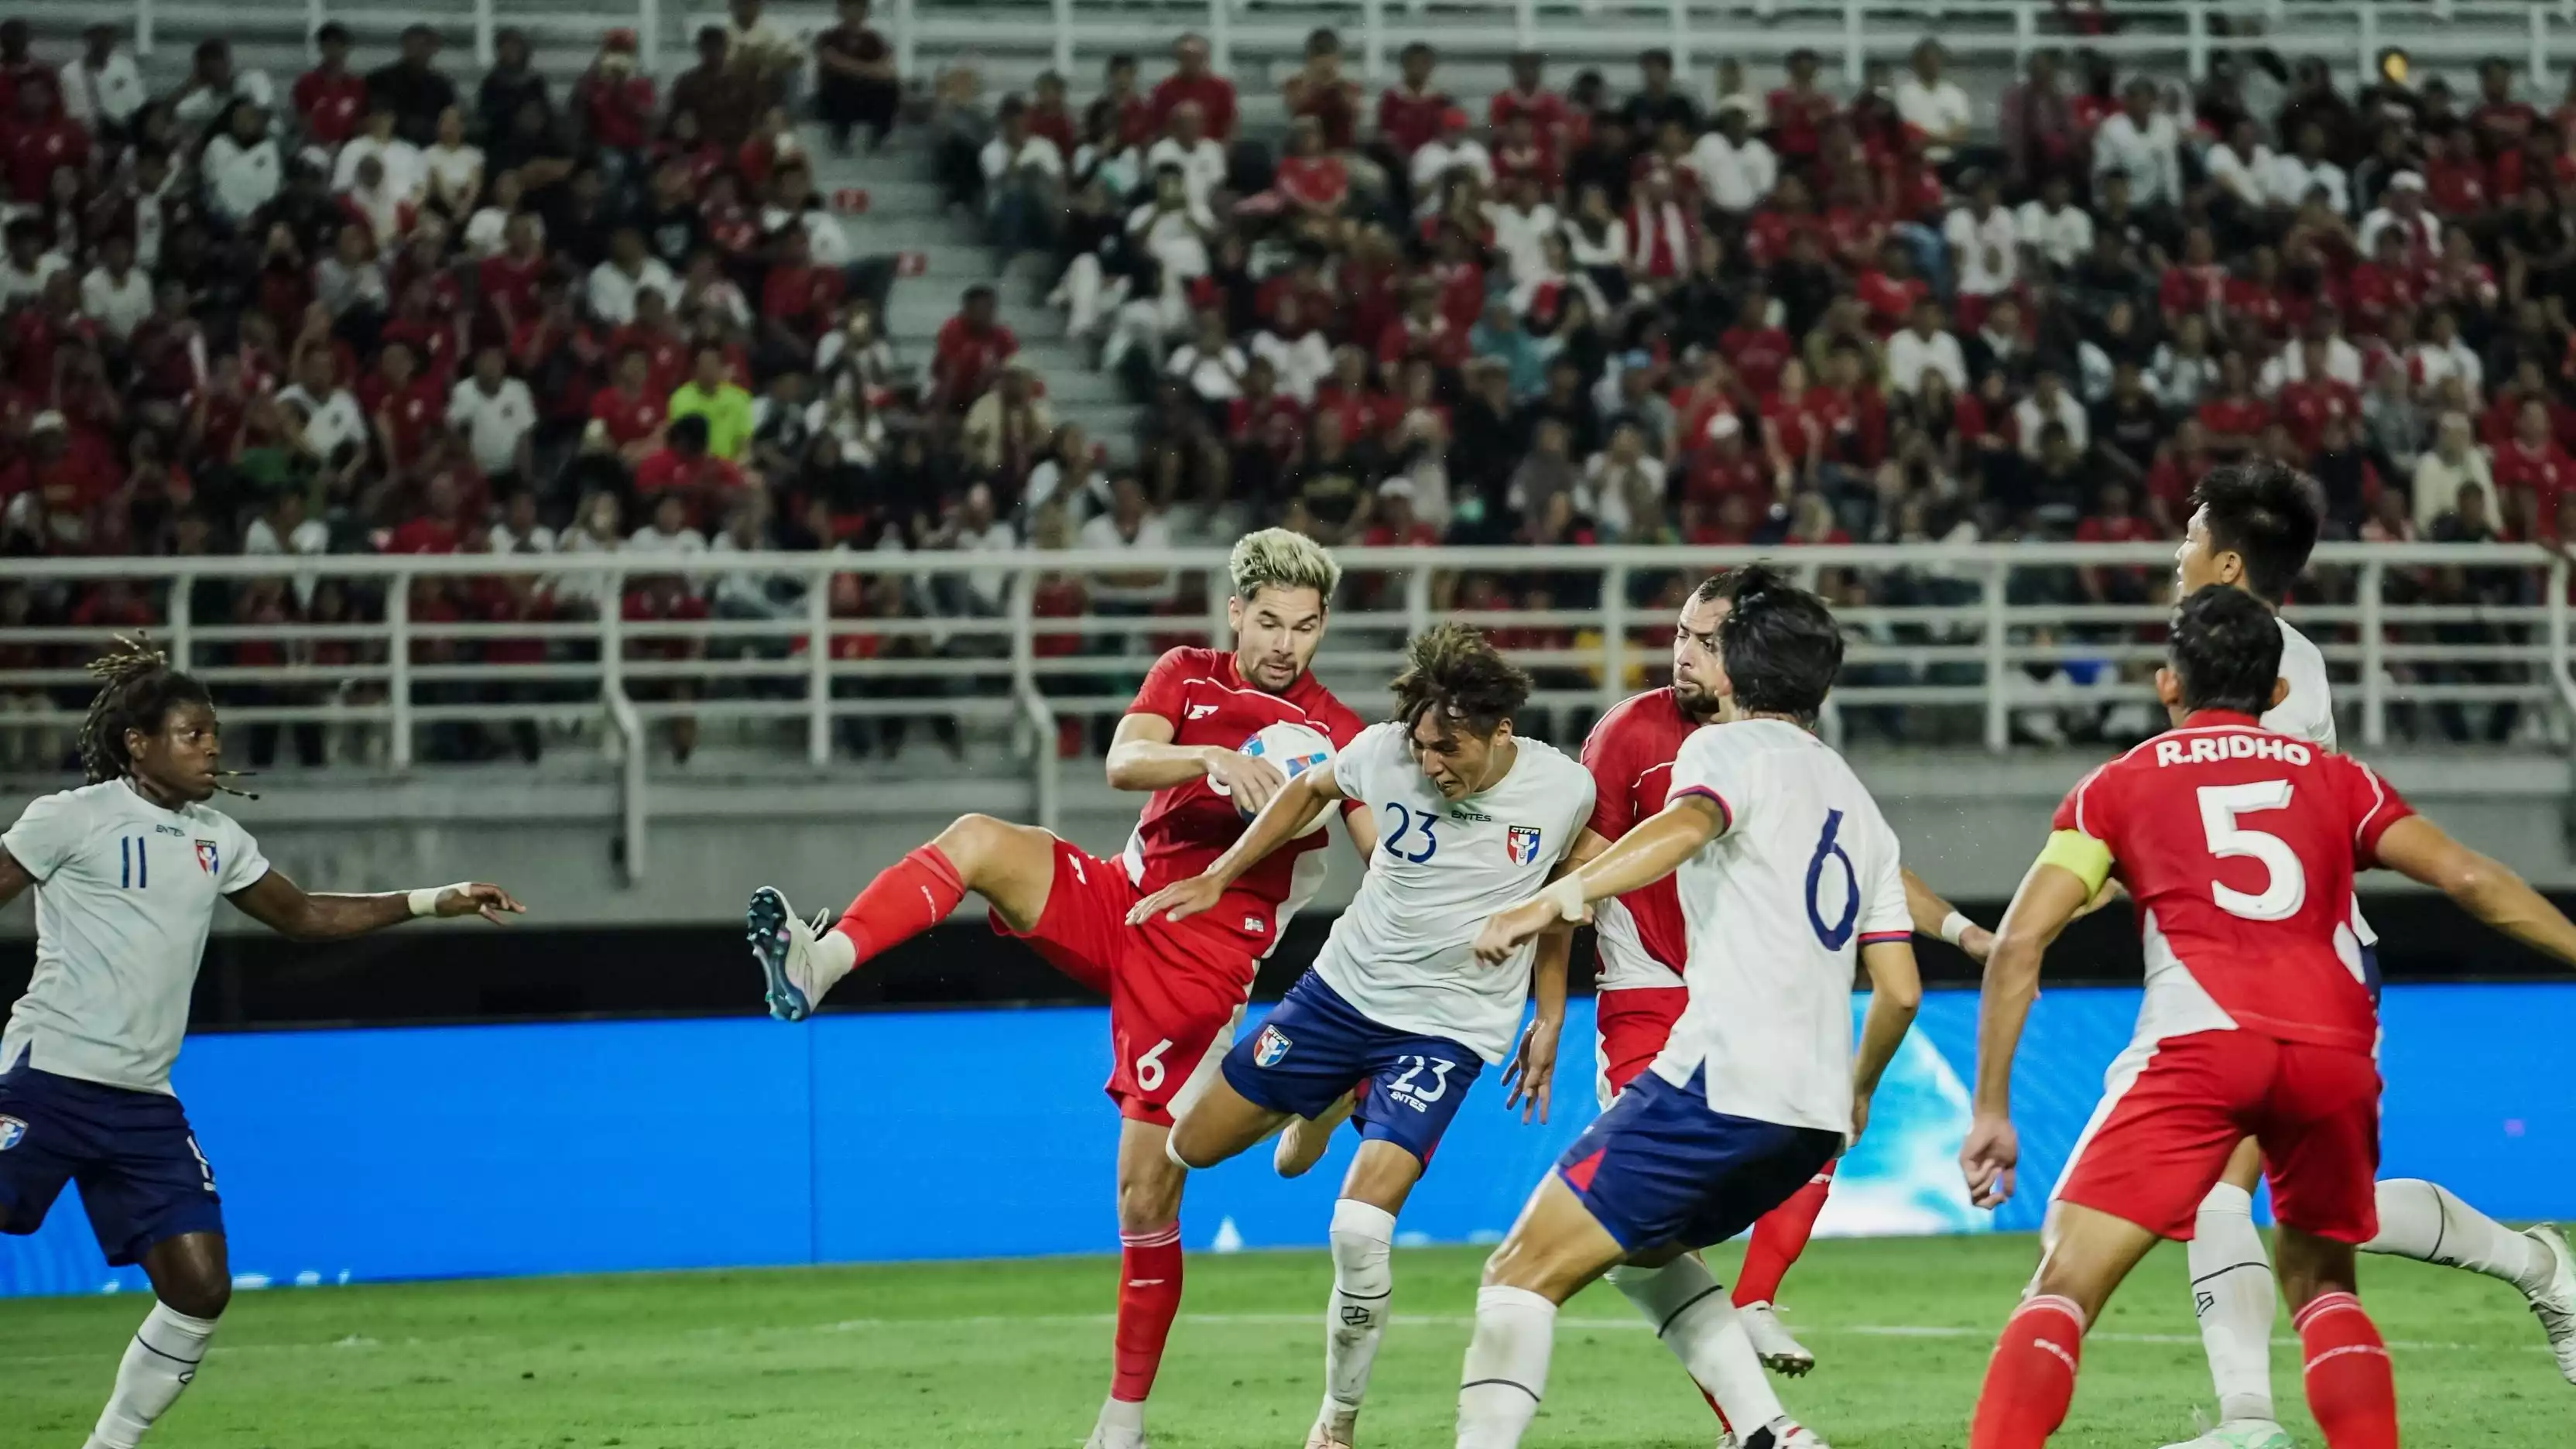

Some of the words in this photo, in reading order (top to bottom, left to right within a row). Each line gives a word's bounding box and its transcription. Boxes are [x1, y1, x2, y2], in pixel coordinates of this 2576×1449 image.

[2156, 735, 2311, 768] R.RIDHO
[1384, 802, 1440, 863] 23
[1451, 810, 1492, 823] ENTES
[122, 835, 147, 889] 11
[2197, 779, 2307, 922] 5
[1805, 808, 1860, 951] 6
[1136, 1038, 1173, 1092] 6
[1386, 1055, 1456, 1102] 23
[1390, 1091, 1427, 1112] ENTES
